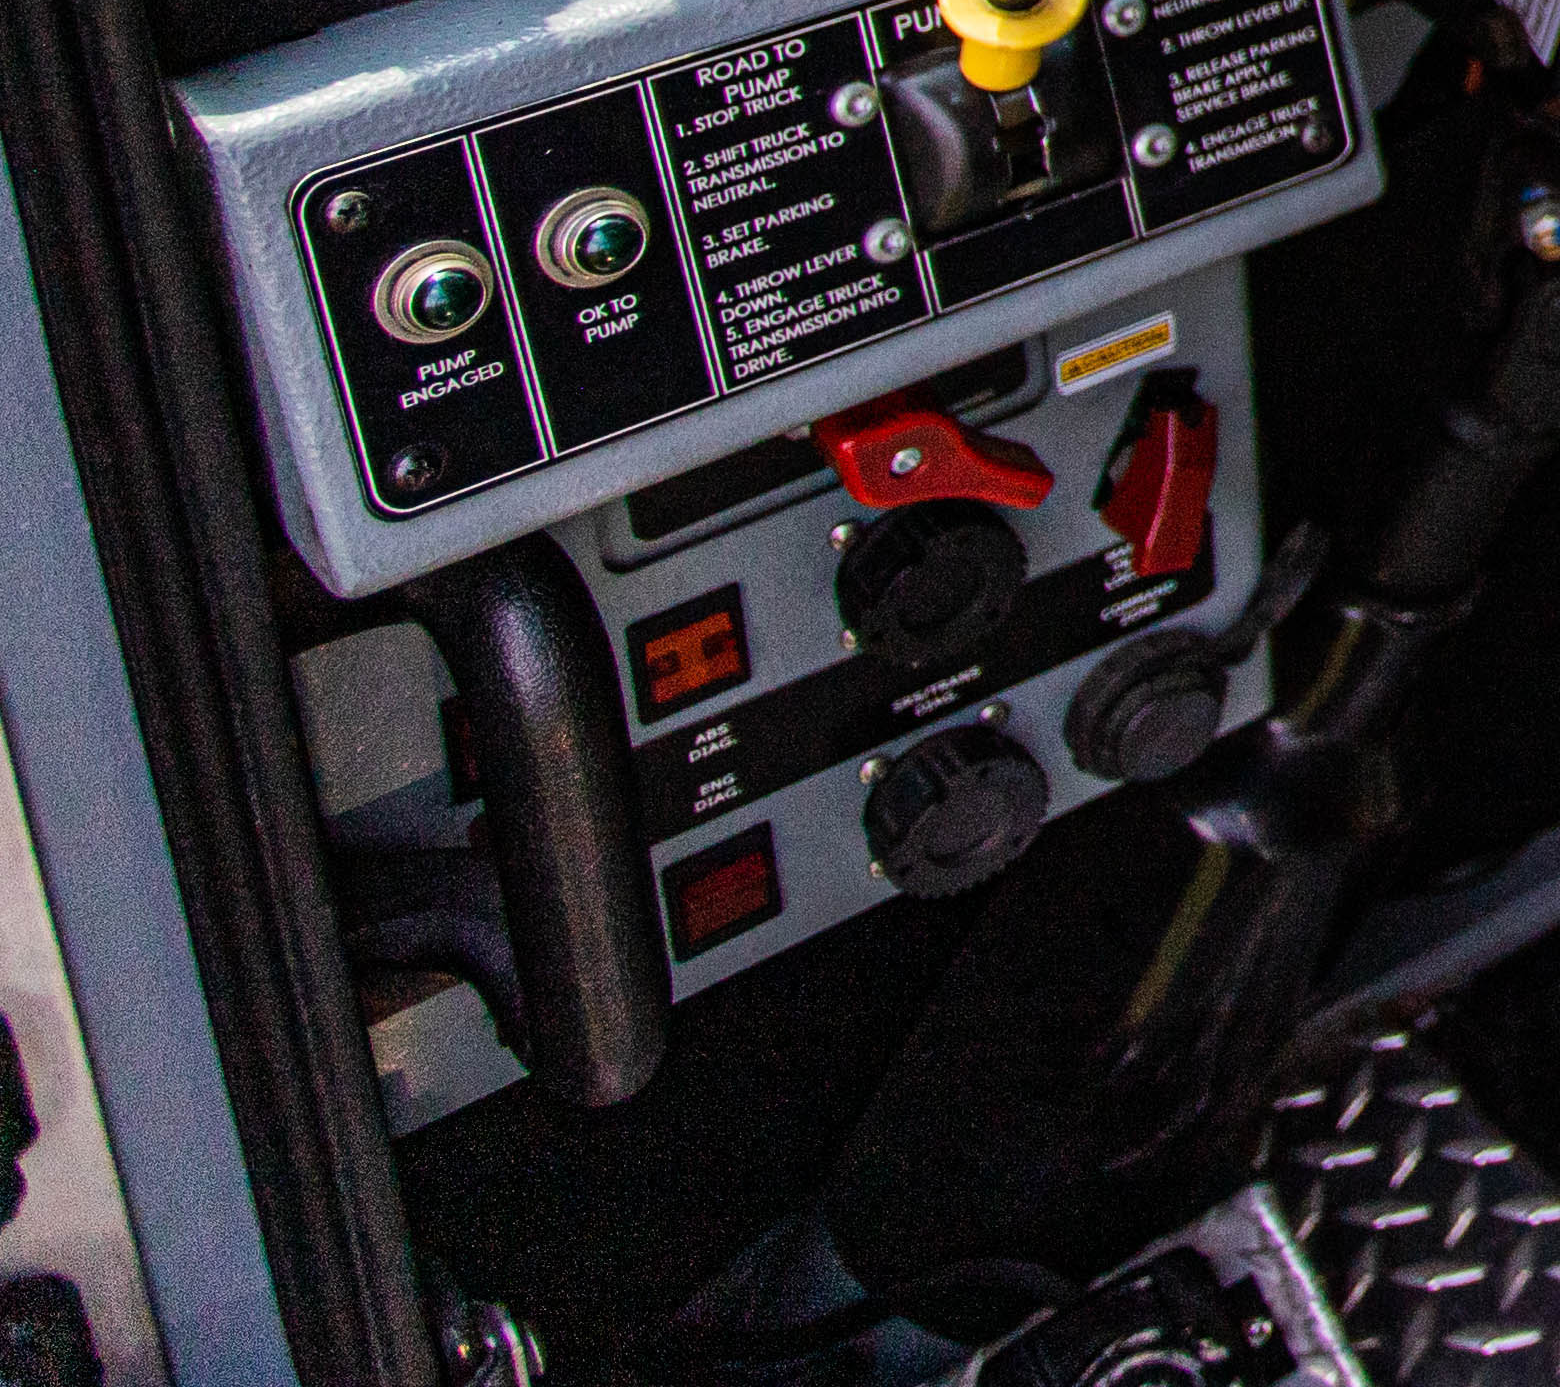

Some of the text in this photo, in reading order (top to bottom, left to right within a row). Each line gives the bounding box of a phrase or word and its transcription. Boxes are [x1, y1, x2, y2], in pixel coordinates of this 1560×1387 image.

[1178, 18, 1234, 49] THROW
[1236, 3, 1282, 30] LEVER
[696, 39, 806, 87] ROAD TO
[1185, 49, 1249, 82] RELEASE
[1250, 25, 1319, 60] PARKING
[724, 68, 791, 104] PUMP
[1172, 59, 1273, 106] BRAKE APPLY
[675, 85, 804, 138] 1. STOP TRUCK
[1176, 90, 1240, 123] SERVICE
[1201, 115, 1268, 150] ENGAGE
[1270, 96, 1320, 124] TRUCK
[684, 123, 811, 176] 2. SHIFT TRUCK
[687, 131, 846, 194] TRANSMISSION TO
[692, 177, 777, 214] NEUTRAL.
[702, 193, 835, 251] 3. SET PARKING
[706, 236, 771, 269] BRAKE.
[716, 244, 859, 304] 4. THROW LEVER
[577, 294, 638, 324] OK TO
[585, 313, 640, 344] PUMP
[720, 290, 788, 324] DOWN.
[726, 272, 885, 342] 5. ENGAGE TRUCK
[728, 287, 901, 361] TRANSMISSION INTO
[417, 349, 477, 382] PUMP
[734, 347, 793, 379] DRIVE.
[400, 361, 504, 410] ENGAGED
[1100, 579, 1178, 622] COMMAND
[688, 736, 738, 763] DIAG.
[695, 723, 730, 745] ABS
[694, 786, 743, 813] DIAG.
[700, 773, 735, 798] ENG
